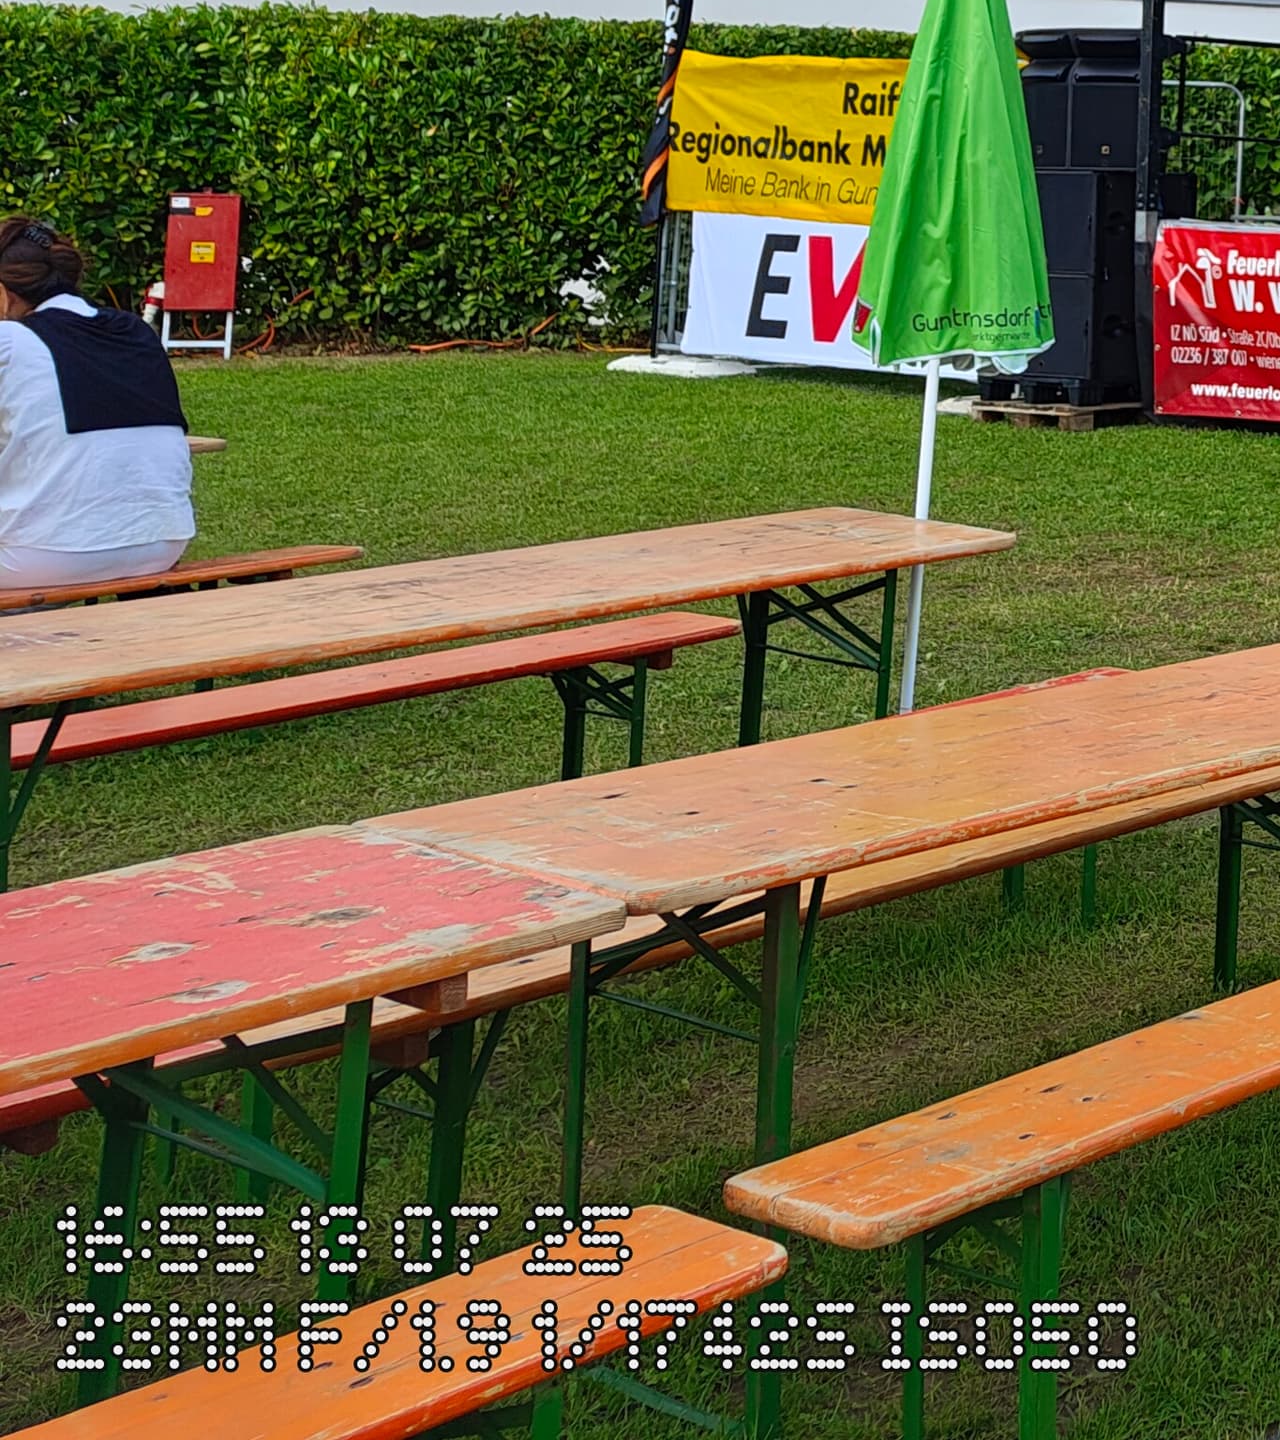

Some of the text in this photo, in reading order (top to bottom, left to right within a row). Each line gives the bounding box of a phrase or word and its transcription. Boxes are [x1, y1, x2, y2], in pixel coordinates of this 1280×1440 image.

[668, 121, 852, 166] Regionalbank
[705, 166, 756, 196] Meine
[760, 171, 811, 201] Bank
[814, 182, 830, 202] in
[1229, 279, 1264, 314] W.
[1198, 325, 1220, 343] Süd
[1171, 346, 1202, 364] 02236
